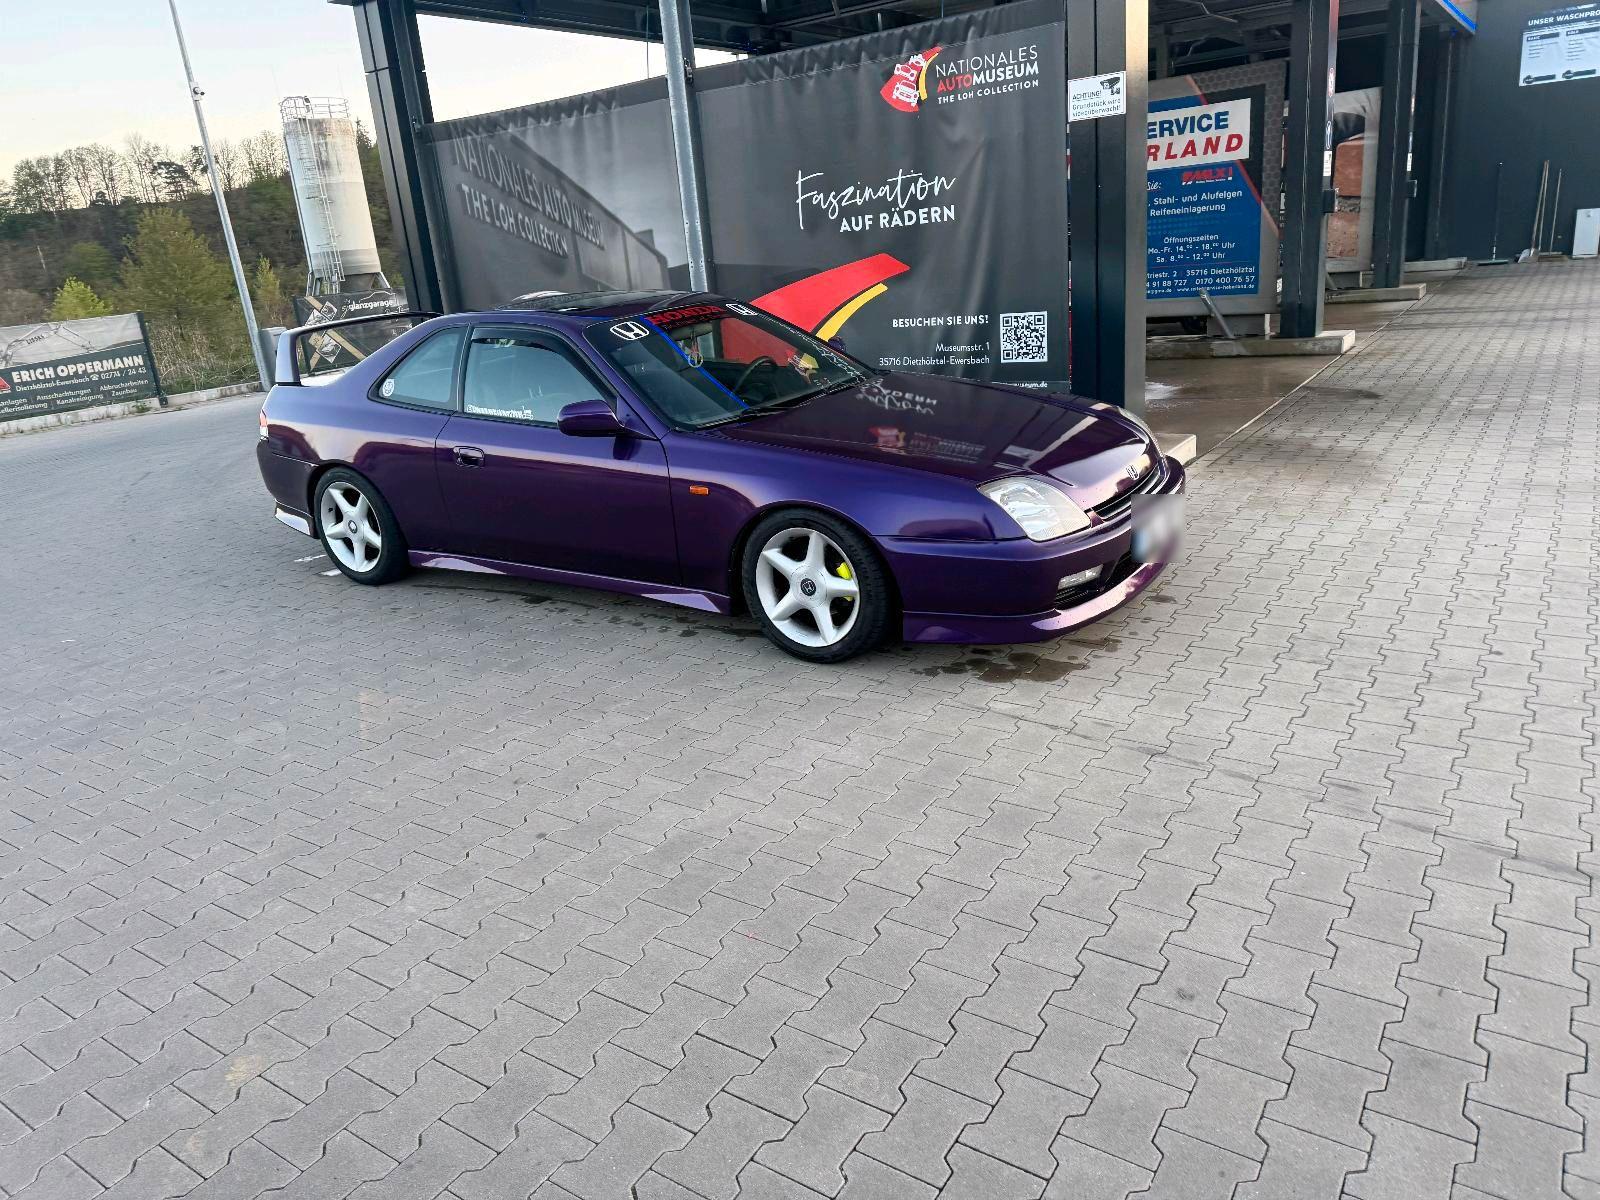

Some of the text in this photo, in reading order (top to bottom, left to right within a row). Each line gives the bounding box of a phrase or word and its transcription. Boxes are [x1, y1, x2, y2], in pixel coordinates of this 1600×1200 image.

[1528, 17, 1554, 26] UNSER
[934, 45, 1038, 78] NATIONALES
[937, 61, 1040, 93] AUTOMUSEUM
[938, 80, 1039, 105] THE LOH COLLECTION
[1072, 90, 1102, 100] ACHTUNG!
[1072, 100, 1106, 110] Grundstück
[1147, 111, 1230, 139] ERVICE
[1147, 134, 1244, 162] RLAND
[452, 127, 542, 212] NATIONALES
[542, 182, 572, 228] AUTO
[796, 169, 957, 230] Faszination
[1154, 190, 1242, 206] Stahl- und Alufelgen
[461, 183, 568, 256] THE LOH COLLECTION
[840, 204, 955, 232] AUF RÄDERN
[1150, 204, 1226, 216] Reifeneinlagerung
[1210, 266, 1255, 274] Dietzhölztal
[348, 300, 393, 311] glanzgarage
[645, 306, 727, 325] HONDA
[892, 314, 989, 328] BESUCHEN SIE UNS!
[935, 342, 984, 352] Museumsstr.
[12, 354, 144, 384] ERICH OPPERMANN
[880, 354, 990, 366] 35716 Dietzhölztal-Ewersbach
[15, 376, 90, 392] Dietzhölztal-Ewersbach
[128, 368, 137, 376] 24
[99, 378, 149, 392] Abbrucharbeiten
[0, 388, 138, 414] ellerisolierung Kanalreinigung Zaunbau
